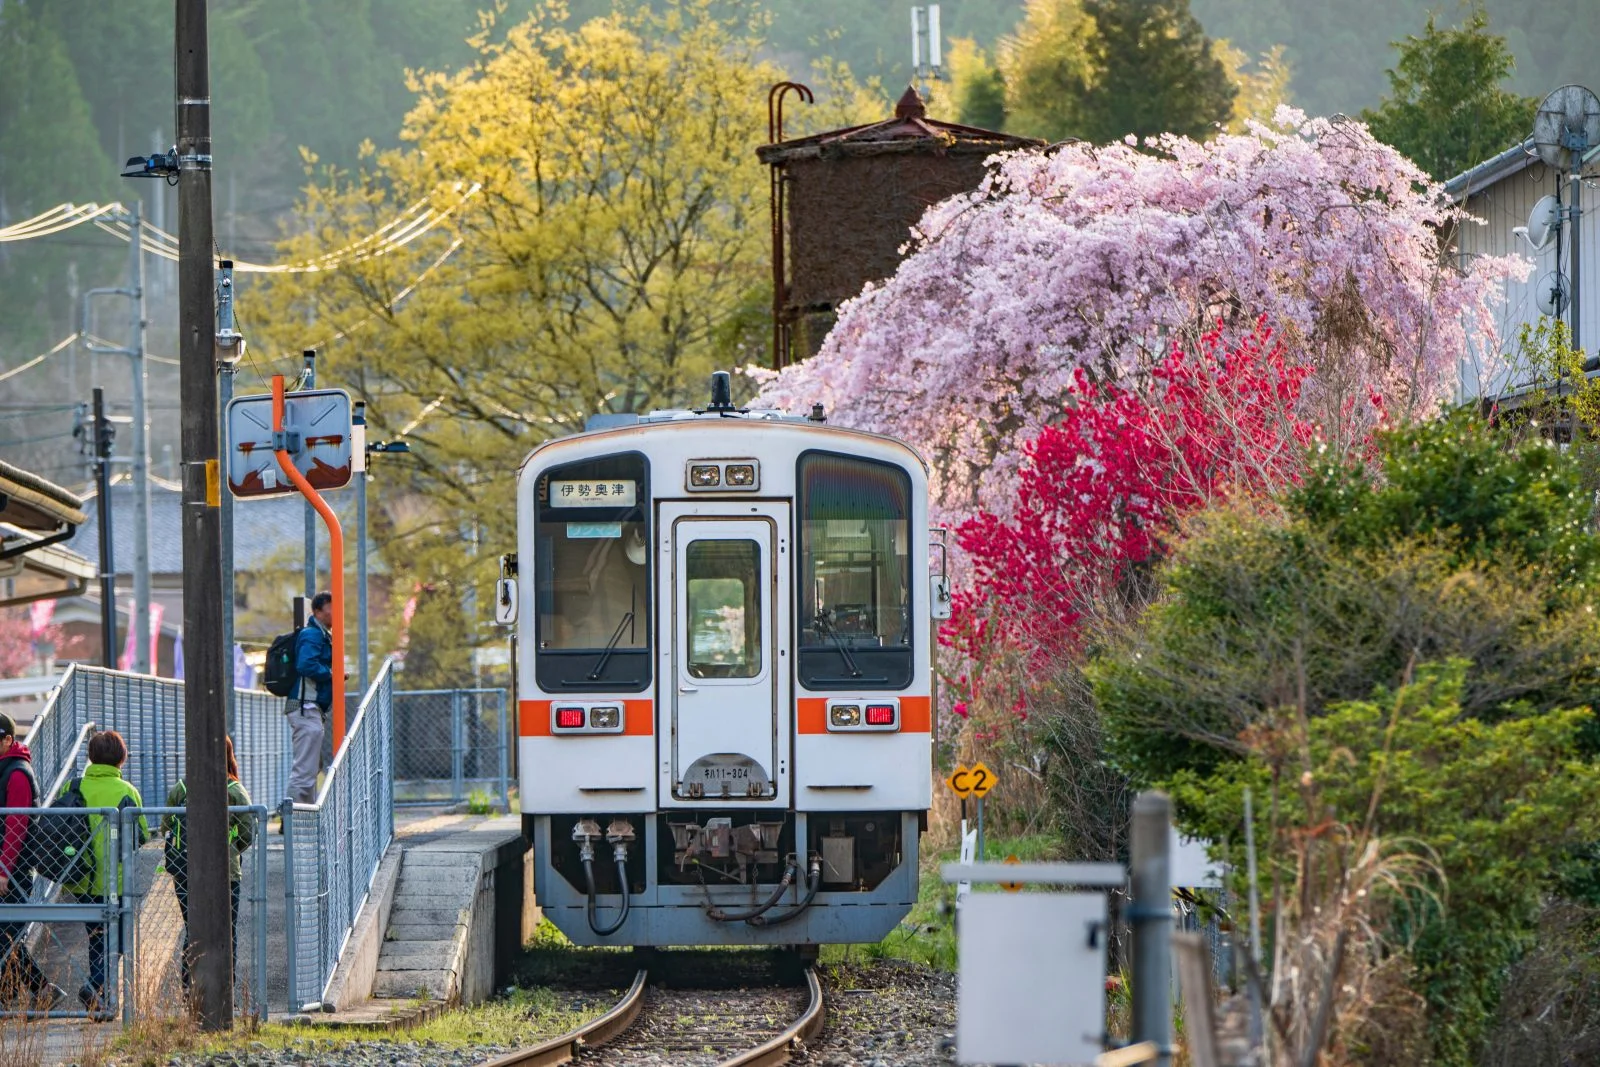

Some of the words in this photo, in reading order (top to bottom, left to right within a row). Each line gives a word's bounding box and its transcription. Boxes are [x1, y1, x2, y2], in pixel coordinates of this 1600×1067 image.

[561, 483, 625, 497] 伊勢奥津
[952, 769, 987, 793] C2
